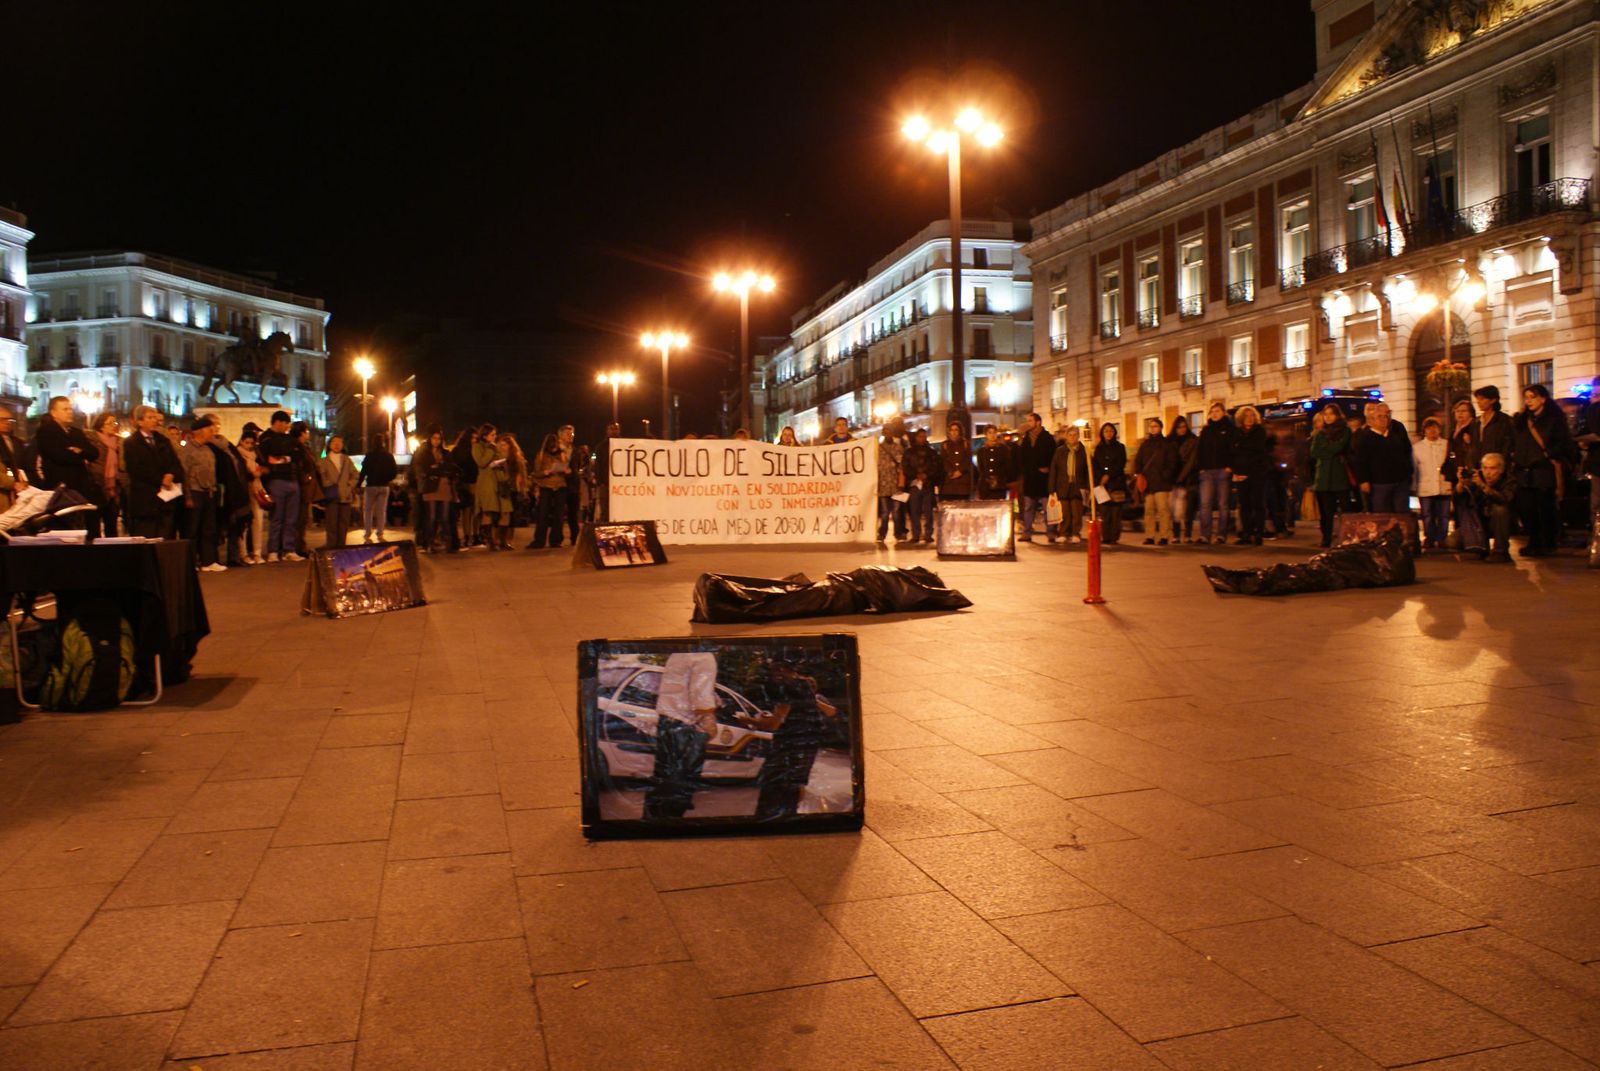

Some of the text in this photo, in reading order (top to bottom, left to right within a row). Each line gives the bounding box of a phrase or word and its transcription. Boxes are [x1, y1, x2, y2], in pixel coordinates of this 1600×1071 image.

[610, 444, 865, 478] CÍRCULO DE SILENCIO
[611, 482, 655, 496] ACCIÓN
[746, 483, 762, 496] EN
[767, 481, 843, 496] SOLIDARIDAD
[716, 495, 860, 511] CON LOS INMIGRANTES
[672, 519, 686, 535] DE
[690, 519, 719, 535] CADA
[727, 518, 751, 536] MES
[755, 518, 768, 535] DE
[811, 516, 821, 535] A
